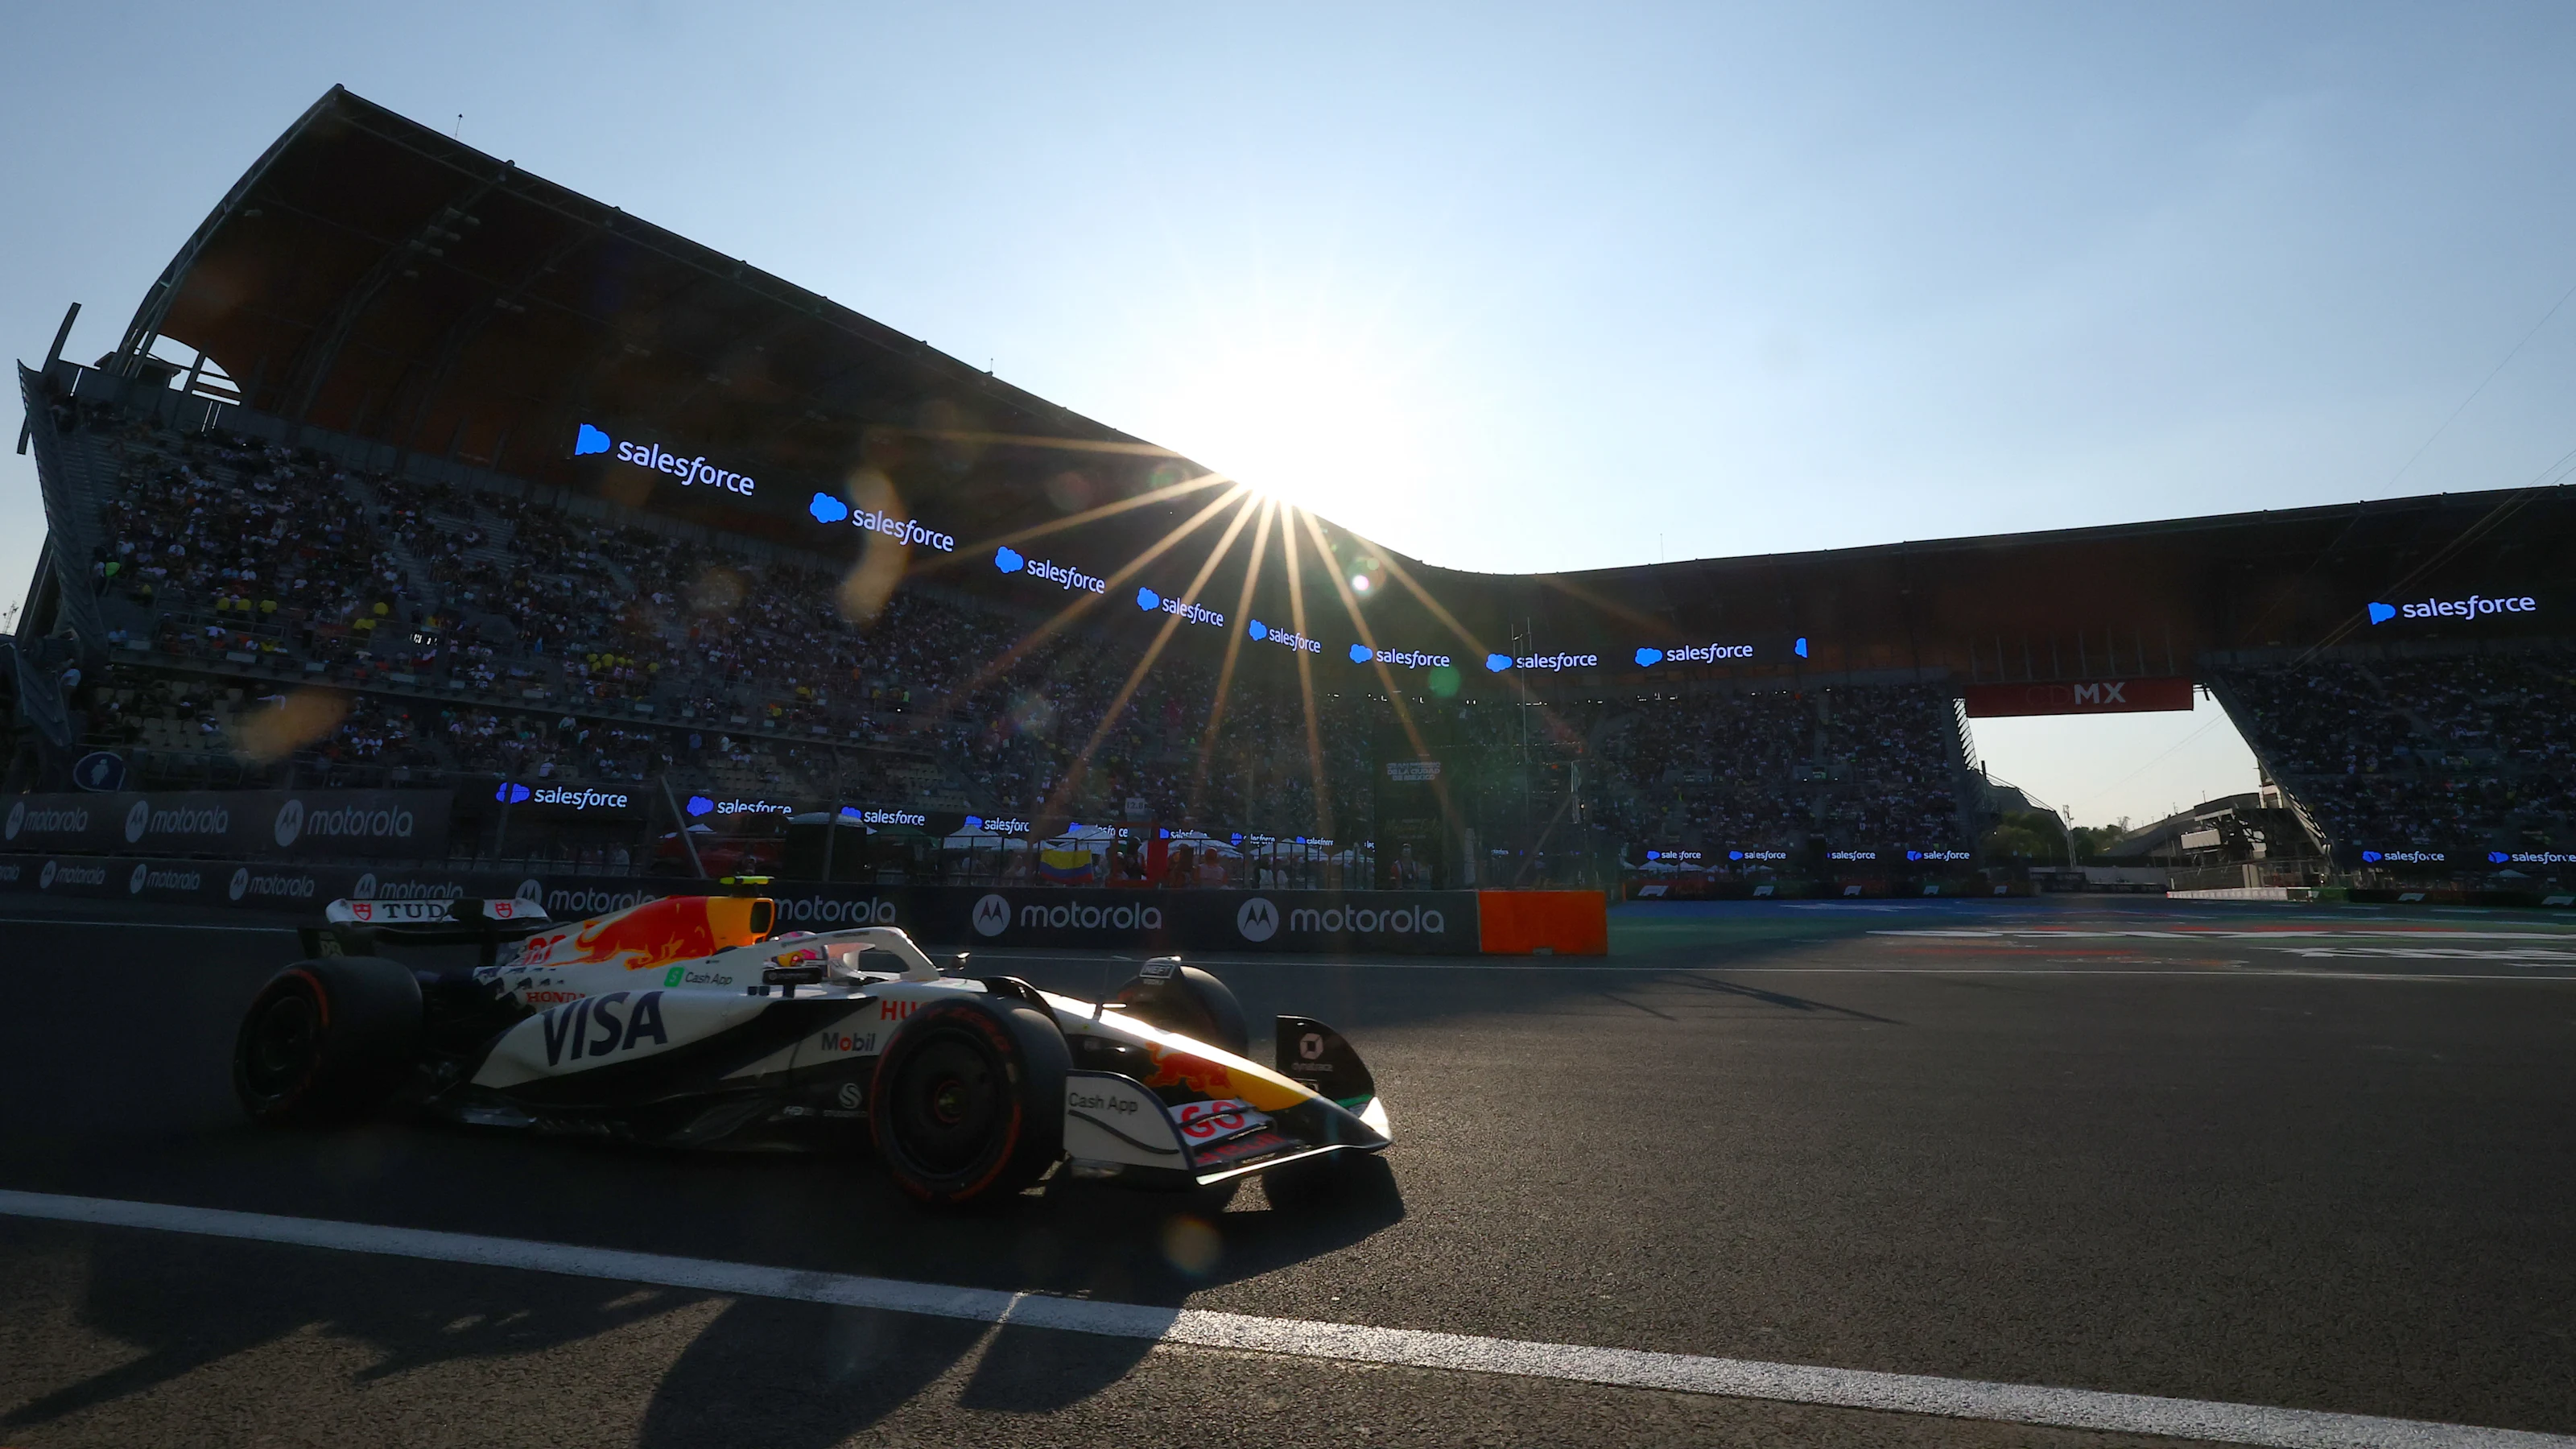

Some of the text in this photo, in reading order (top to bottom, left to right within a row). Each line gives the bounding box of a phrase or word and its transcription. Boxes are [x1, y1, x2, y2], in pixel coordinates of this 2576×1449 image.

[617, 440, 755, 496] salesforce
[852, 507, 955, 552] salesforce
[1026, 559, 1105, 594] salesforce
[1162, 597, 1224, 627] salesforce
[2401, 594, 2537, 621] salesforce
[1269, 627, 1321, 654] salesforce
[1376, 646, 1451, 669] salesforce
[1516, 651, 1598, 672] salesforce
[1666, 642, 1753, 664] salesforce
[534, 786, 628, 810] salesforce
[23, 806, 89, 832] motorola
[149, 806, 229, 834] motorola
[306, 806, 413, 837] motorola
[863, 809, 925, 827] salesforce
[984, 816, 1030, 835] salesforc
[1744, 850, 1786, 861] salesforce
[1831, 850, 1876, 861] salesforce
[56, 865, 105, 885] motorola
[147, 869, 200, 890] motorola
[249, 874, 315, 898] motorola
[379, 879, 464, 899] motorola
[382, 904, 445, 918] TUD
[1021, 902, 1162, 931] motorola
[1290, 905, 1444, 934] motorola
[685, 972, 733, 986] Cash App
[526, 992, 586, 1003] HOND
[542, 992, 667, 1067] VISA
[822, 1032, 876, 1051] Mobil
[1069, 1093, 1138, 1113] Cash App
